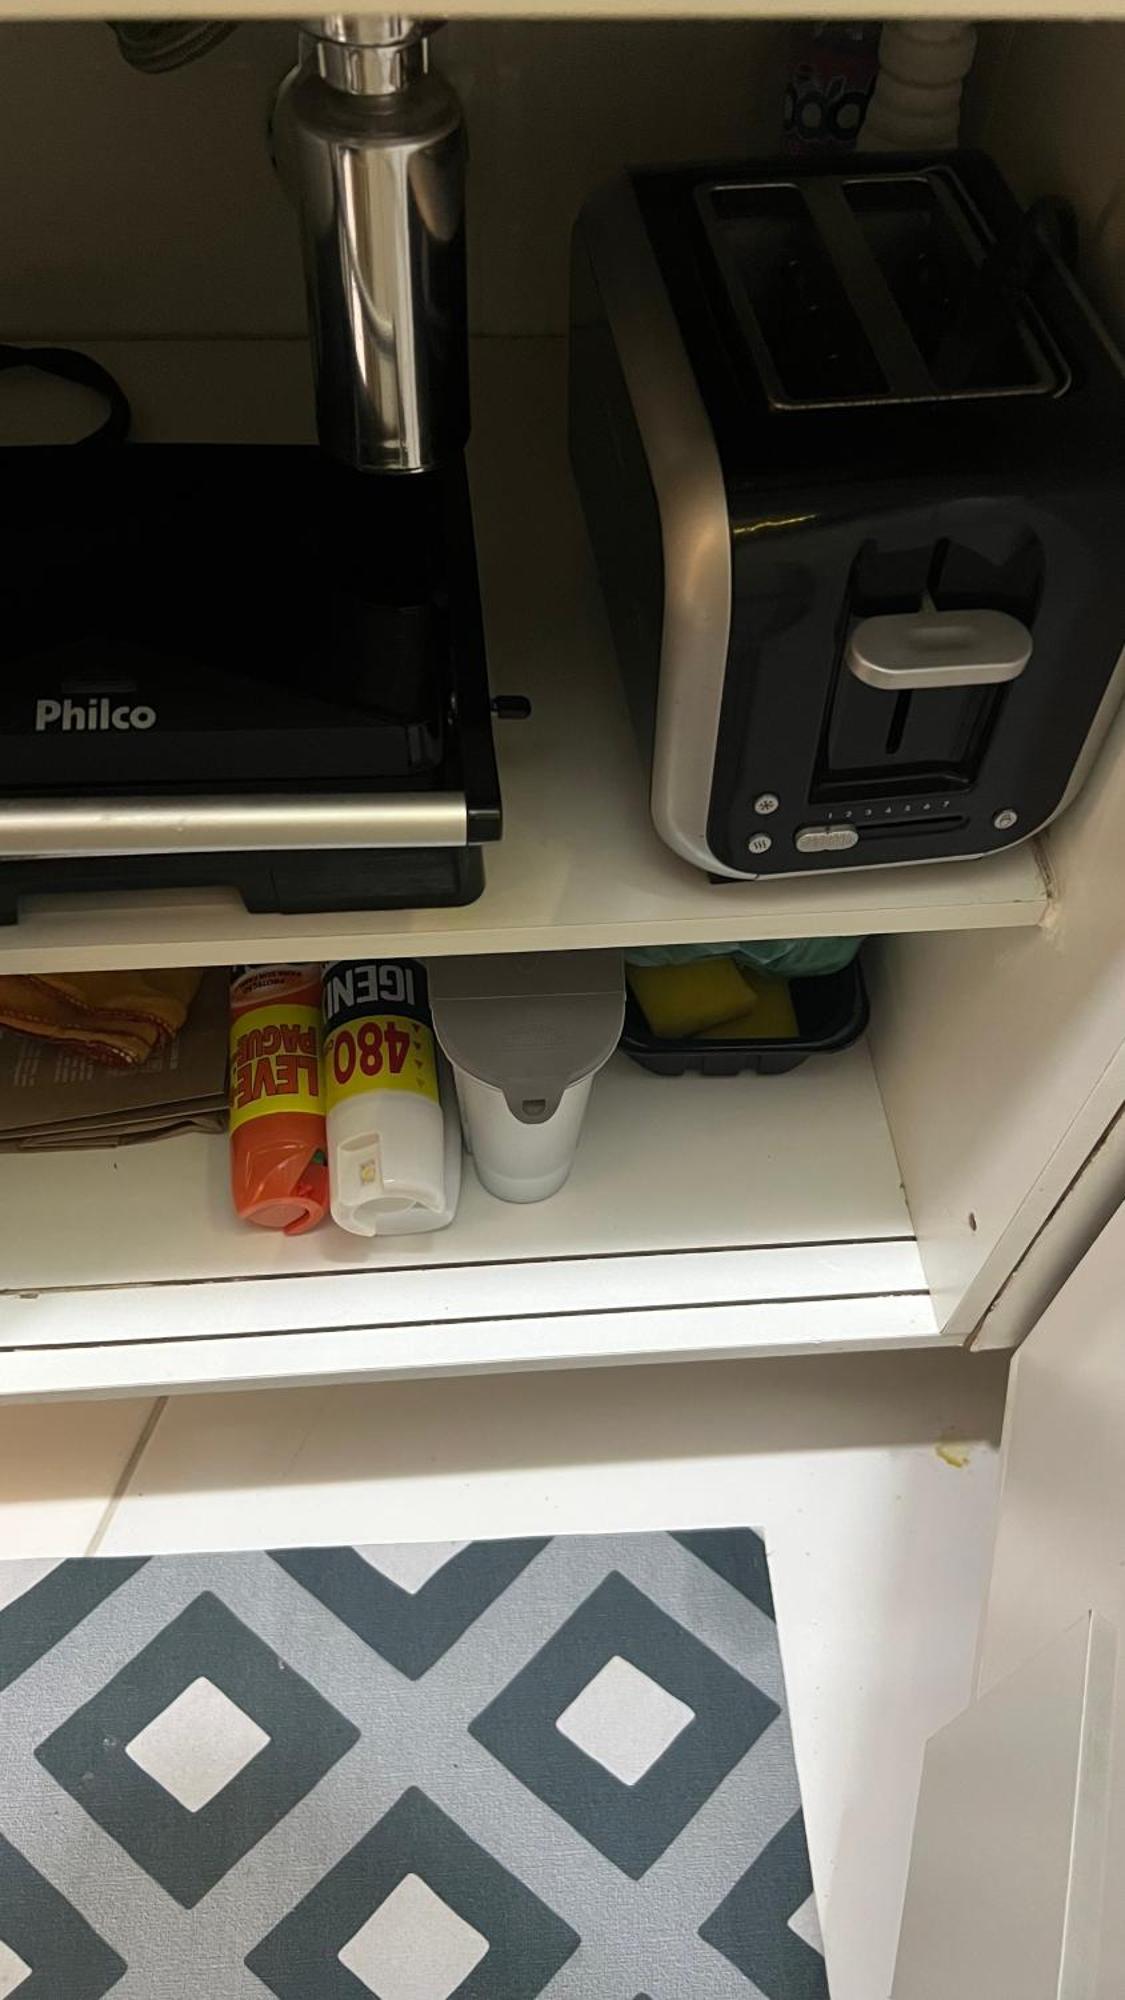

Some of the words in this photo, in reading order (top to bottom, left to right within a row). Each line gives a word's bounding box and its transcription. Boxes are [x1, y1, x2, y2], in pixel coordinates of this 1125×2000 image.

[35, 698, 157, 731] Philco
[235, 1024, 317, 1062] PAGUE
[334, 1022, 410, 1085] 480
[237, 1055, 319, 1108] LEVE
